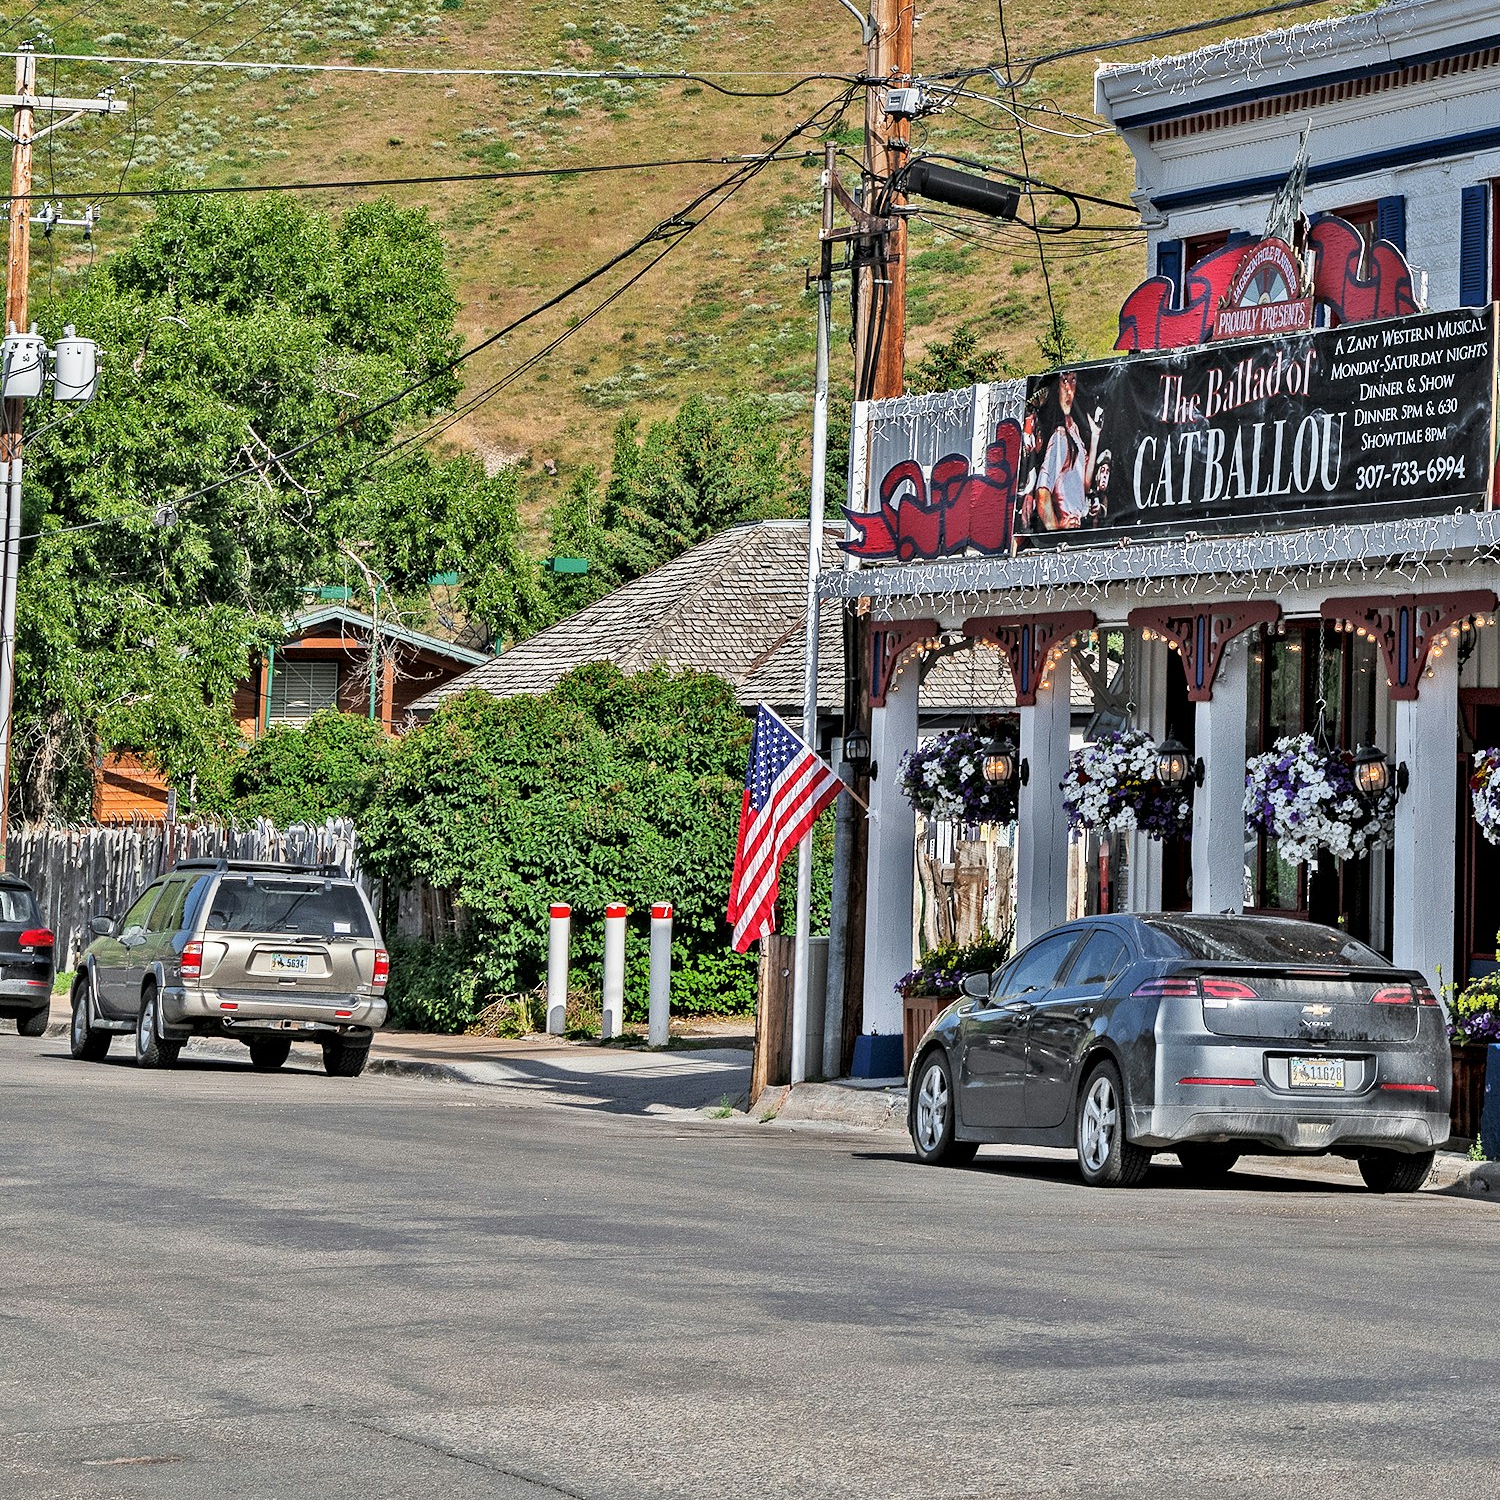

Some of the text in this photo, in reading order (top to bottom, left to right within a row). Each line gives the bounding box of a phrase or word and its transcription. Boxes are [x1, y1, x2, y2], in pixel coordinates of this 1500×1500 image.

[1218, 302, 1306, 336] PROUDLY PRESENTS
[1335, 317, 1486, 355] A ZANY WESTERN MUSICAL
[1330, 342, 1488, 381] MONDAY-SATURDAY NIGHTS
[1159, 348, 1317, 423] The Ballad of
[1360, 374, 1456, 401] DINNER & SHOW
[1354, 398, 1458, 427] DINNER 5PM & 6:30
[1361, 427, 1447, 451] SHOWTIME 8PM
[1355, 454, 1466, 491] 307-733-6994
[1302, 1018, 1332, 1028] VOLT
[1311, 1066, 1342, 1081] 11628
